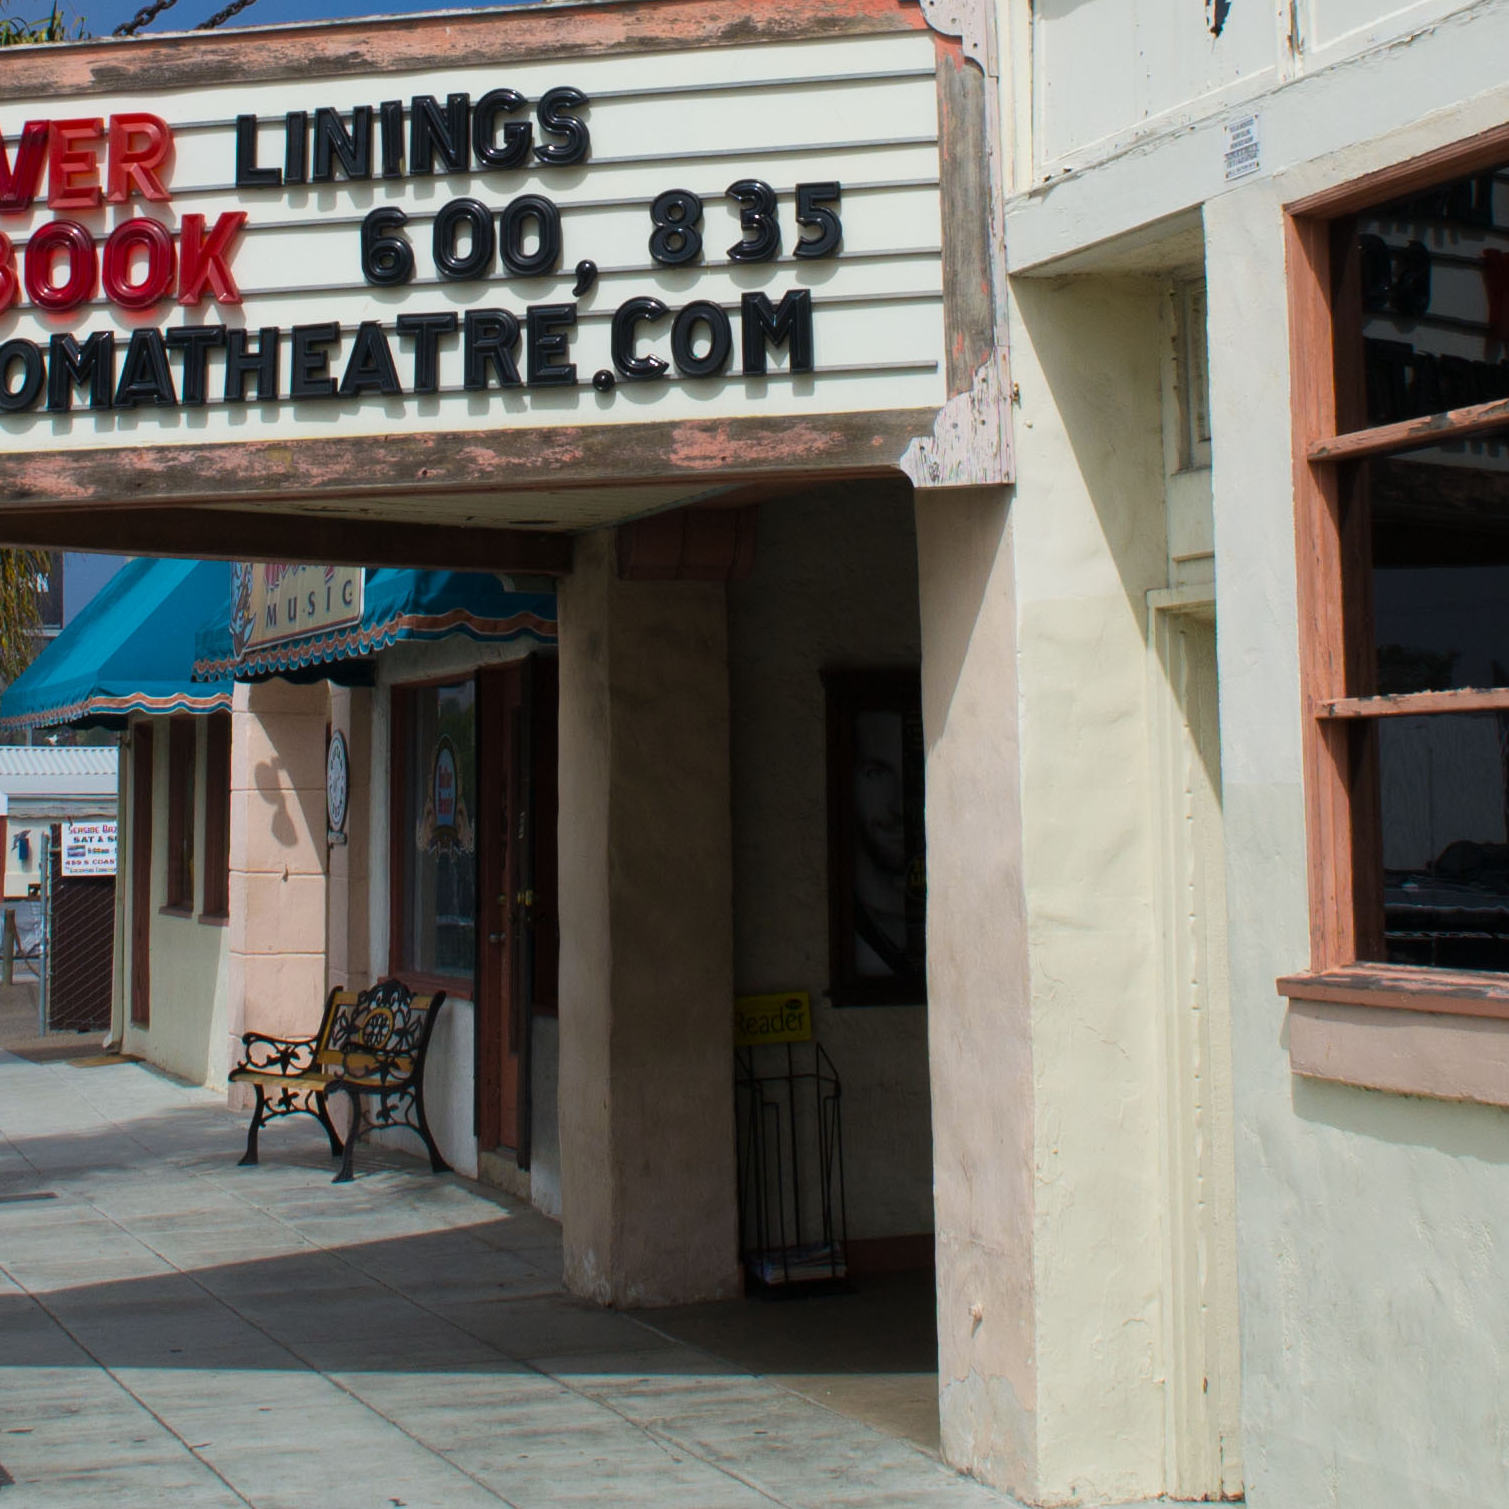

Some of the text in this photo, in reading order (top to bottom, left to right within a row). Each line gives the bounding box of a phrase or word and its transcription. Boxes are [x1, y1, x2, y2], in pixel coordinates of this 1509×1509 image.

[234, 86, 592, 188] LININGS
[360, 194, 598, 297] 600,
[648, 179, 843, 266] 835
[265, 579, 354, 628] MUSIC
[73, 835, 95, 843] SAT
[734, 1003, 805, 1036] Reader
